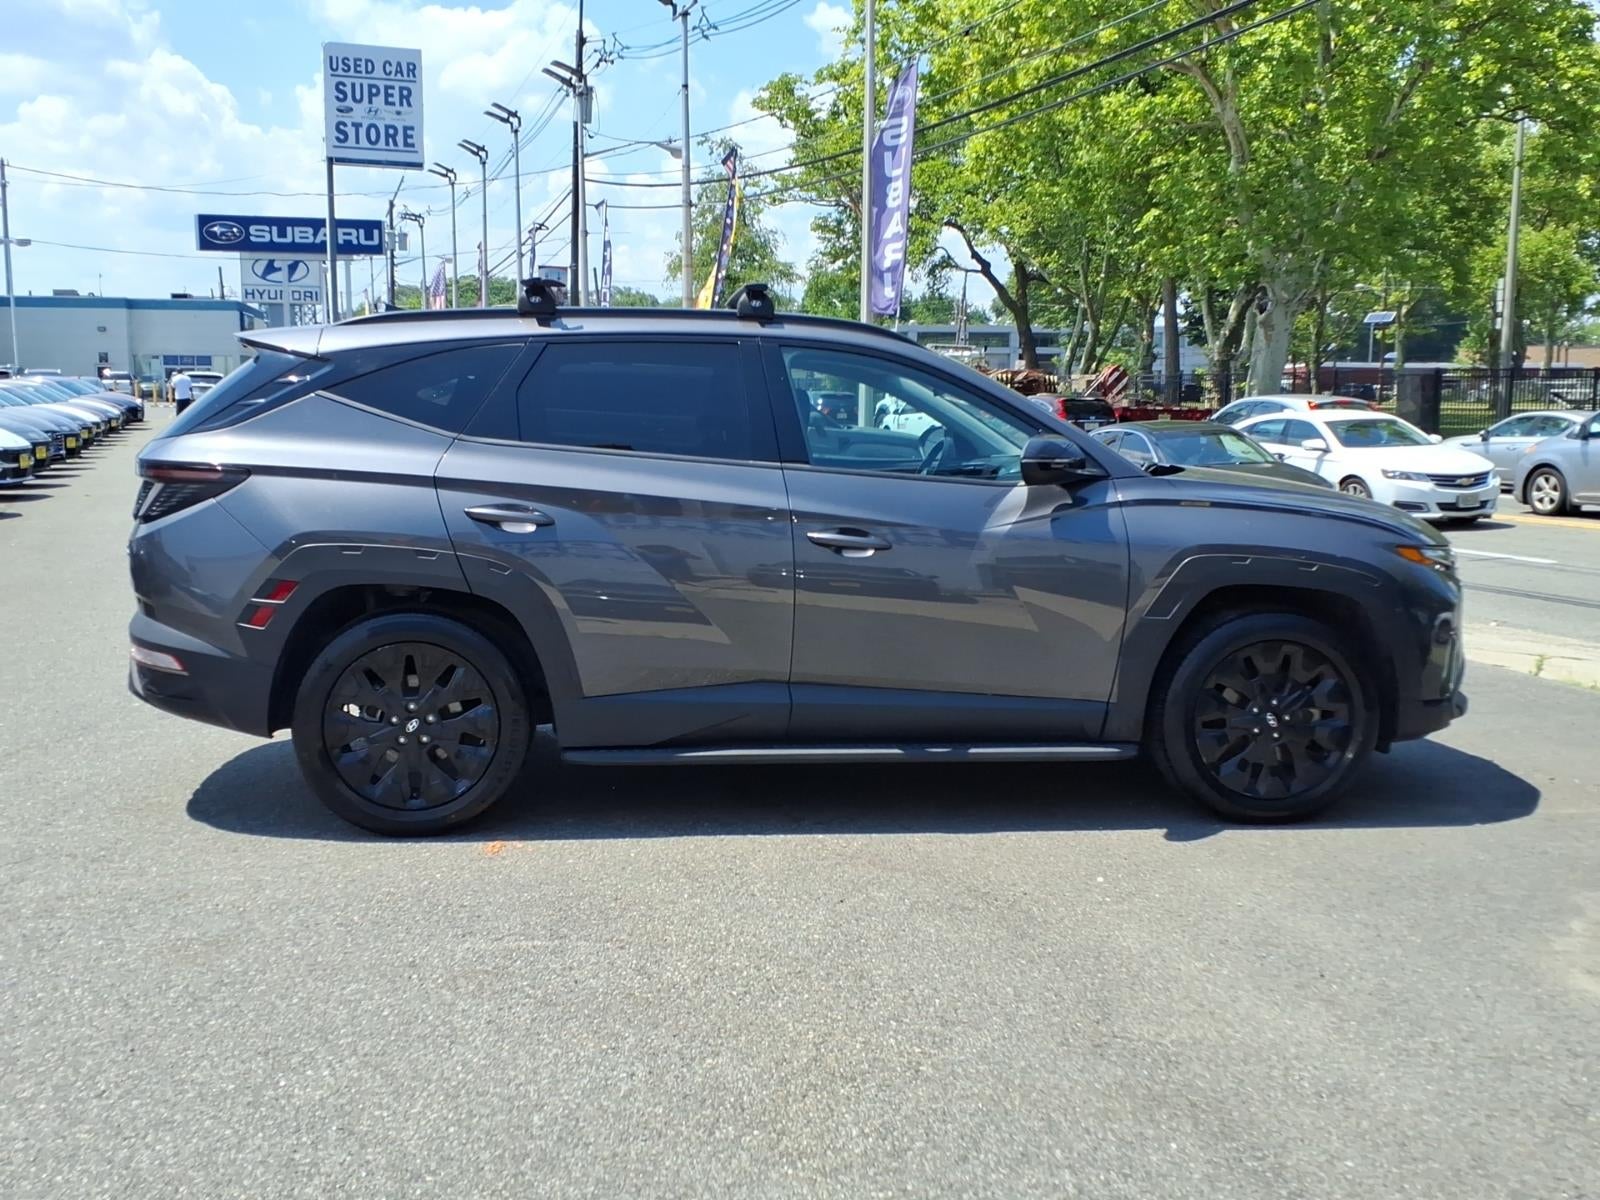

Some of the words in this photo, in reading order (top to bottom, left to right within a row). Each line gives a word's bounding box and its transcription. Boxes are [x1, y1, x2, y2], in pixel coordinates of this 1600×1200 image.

[329, 55, 375, 74] USED
[382, 60, 417, 78] CAR
[334, 80, 413, 108] SUPER
[334, 120, 416, 148] STORE
[248, 224, 379, 246] SUBARU
[244, 289, 319, 302] HYUDAI
